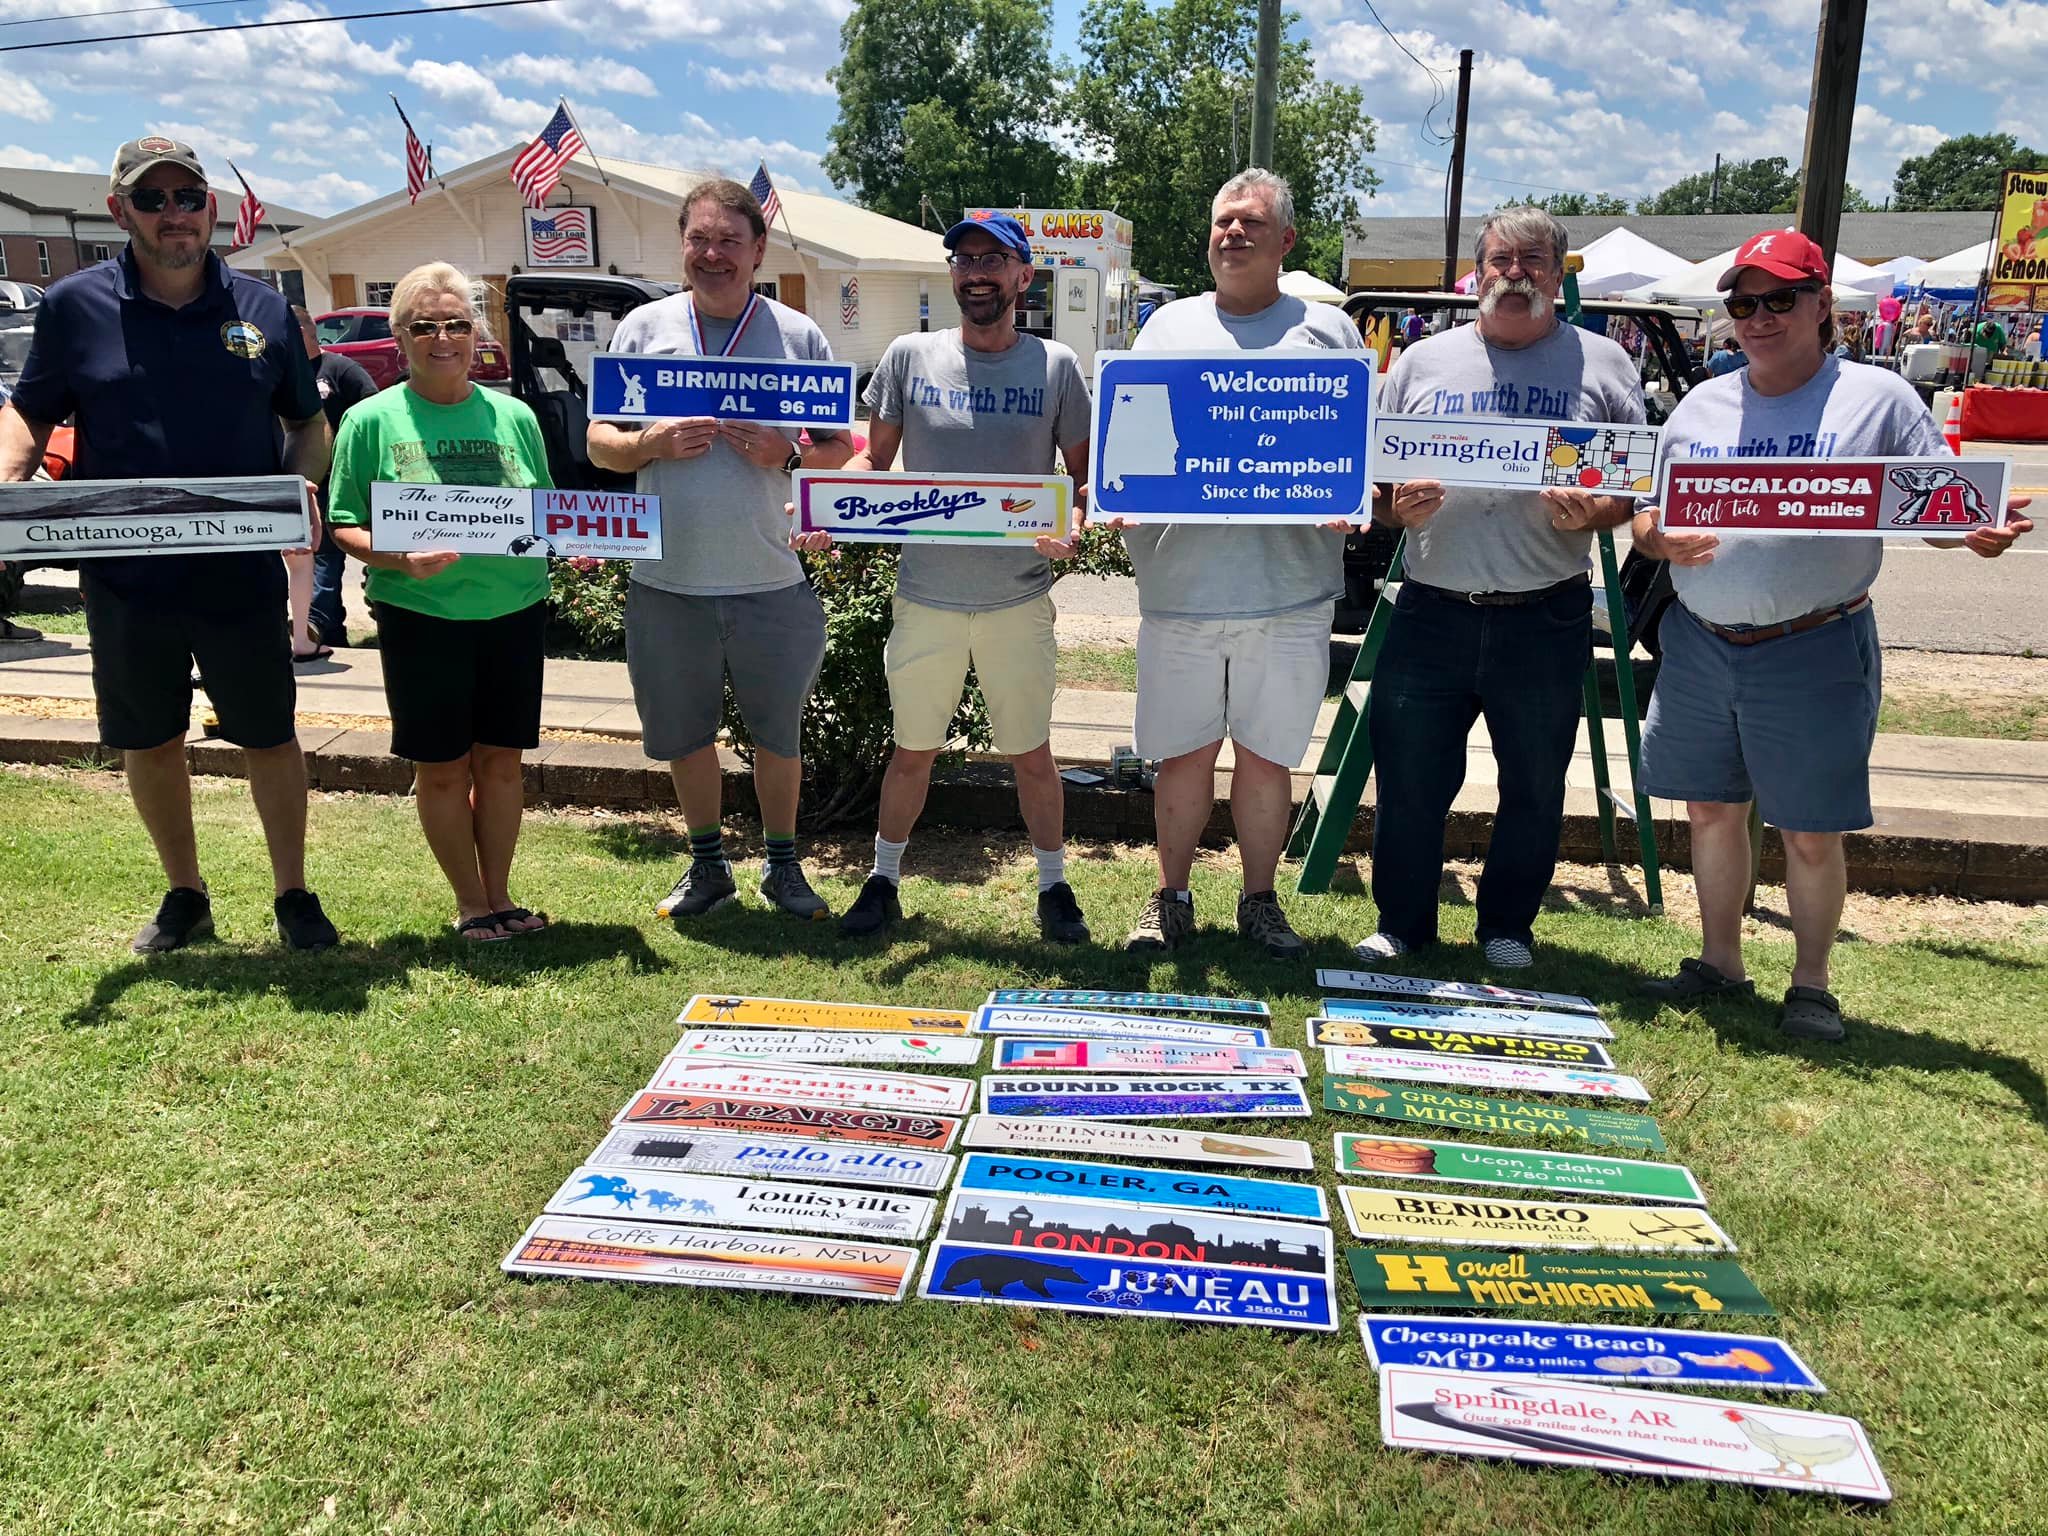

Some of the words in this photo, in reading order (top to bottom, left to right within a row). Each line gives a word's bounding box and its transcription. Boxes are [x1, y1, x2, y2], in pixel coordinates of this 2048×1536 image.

[1041, 213, 1104, 239] CAKES
[656, 370, 844, 393] BIRMINGHAM
[1200, 371, 1349, 398] Welcoming
[719, 395, 755, 412] AL
[779, 400, 805, 415] 96
[812, 402, 837, 416] mi
[911, 376, 941, 408] I'm
[948, 384, 995, 414] with
[1002, 387, 1044, 417] Phil
[1432, 389, 1464, 416] I'm
[1471, 383, 1520, 414] with
[1524, 386, 1568, 418] Phil
[1208, 406, 1245, 421] Phil
[1249, 407, 1338, 425] Campbells
[1257, 433, 1276, 447] to
[1383, 435, 1539, 463] Springfield
[1690, 442, 1719, 457] I'm
[1727, 438, 1778, 457] with
[1786, 433, 1837, 457] Phil
[1185, 458, 1230, 473] Phil
[1237, 458, 1352, 477] Campbell
[1502, 462, 1530, 473] Ohio
[1201, 483, 1248, 500] Since
[1253, 483, 1281, 499] the
[1285, 484, 1333, 499] 1880s
[1675, 477, 1872, 495] TUSCALOOSA
[399, 488, 437, 503] The
[446, 490, 514, 509] Twenty
[546, 493, 579, 512] I'M
[587, 494, 646, 514] WITH
[833, 488, 986, 522] Brooklyn
[1920, 485, 1971, 523] A
[382, 509, 419, 522] Phil
[425, 510, 525, 525] Campbells
[1680, 499, 1723, 524] Roll
[1778, 501, 1805, 516] 90
[1809, 502, 1865, 517] miles
[26, 523, 183, 542] Chattanooga,
[189, 520, 226, 536] TN
[233, 525, 253, 535] 196
[257, 524, 273, 534] mi
[411, 526, 425, 541] of
[424, 527, 464, 541] June
[466, 530, 497, 540] 2011
[546, 513, 649, 539] PHIL
[1007, 520, 1037, 529] 1,018
[1041, 520, 1053, 528] mi
[566, 543, 591, 551] people
[593, 543, 620, 552] helping
[995, 1013, 1102, 1027] Adelaide,
[1112, 1020, 1212, 1035] Australia
[702, 1034, 797, 1043] Bowral
[814, 1036, 880, 1045] NSW
[723, 1045, 845, 1053] Australia
[1390, 1029, 1589, 1054] QUANTICO
[1106, 1046, 1230, 1057] Schoolcraft
[1124, 1057, 1199, 1065] Michigan
[1430, 1042, 1474, 1052] VA
[1555, 1053, 1583, 1061] mi
[1346, 1053, 1497, 1074] Easthampton,
[666, 1080, 855, 1098] tennessee
[739, 1074, 916, 1095] Franklin
[992, 1082, 1119, 1092] ROUND
[1129, 1082, 1235, 1092] ROCK,
[1243, 1082, 1292, 1091] TX
[1400, 1092, 1489, 1111] GRASS
[1500, 1104, 1570, 1120] LAKE
[626, 1098, 944, 1139] LAFARGE
[709, 1121, 799, 1133] Wisconsin
[1403, 1104, 1589, 1138] MICHIGAN
[996, 1122, 1179, 1143] NOTTINGHAM
[1010, 1134, 1091, 1144] England
[735, 1147, 829, 1161] palo
[841, 1153, 922, 1169] alto
[752, 1163, 830, 1173] california
[1461, 1153, 1533, 1169] Ucon,
[1541, 1160, 1623, 1176] Idaho!
[988, 1165, 1156, 1192] POOLER,
[1172, 1181, 1230, 1197] GA
[1555, 1175, 1605, 1185] miles
[737, 1186, 911, 1213] Louisville
[1213, 1200, 1248, 1210] 480
[1256, 1204, 1281, 1213] mi
[748, 1203, 846, 1220] Kentucky
[1395, 1198, 1589, 1223] BENDIGO
[1472, 1221, 1590, 1232] AUSTRALIA
[587, 1228, 655, 1244] Coffs
[668, 1234, 800, 1257] Harbour,
[815, 1248, 892, 1264] NSW
[1012, 1230, 1206, 1262] LONDON
[664, 1266, 747, 1279] Australia
[820, 1278, 846, 1287] km
[1617, 1268, 1641, 1276] Phil
[1098, 1268, 1309, 1306] JUNEAU
[1466, 1280, 1655, 1308] MICHIGAN
[1194, 1299, 1232, 1313] AK
[1244, 1304, 1282, 1312] 3560
[1288, 1309, 1307, 1317] mi
[1381, 1327, 1557, 1349] Chesapeake
[1565, 1334, 1666, 1352] Beach
[1417, 1348, 1495, 1368] MD
[1504, 1355, 1534, 1366] 823
[1539, 1356, 1586, 1367] miles
[1434, 1389, 1617, 1424] Springdale,
[1630, 1410, 1677, 1428] AR
[1463, 1412, 1498, 1423] (just
[1503, 1418, 1531, 1427] 508
[1537, 1419, 1577, 1430] miles
[1580, 1424, 1621, 1436] down
[1627, 1428, 1657, 1440] that
[1663, 1434, 1697, 1444] road
[1702, 1437, 1748, 1451] there)
